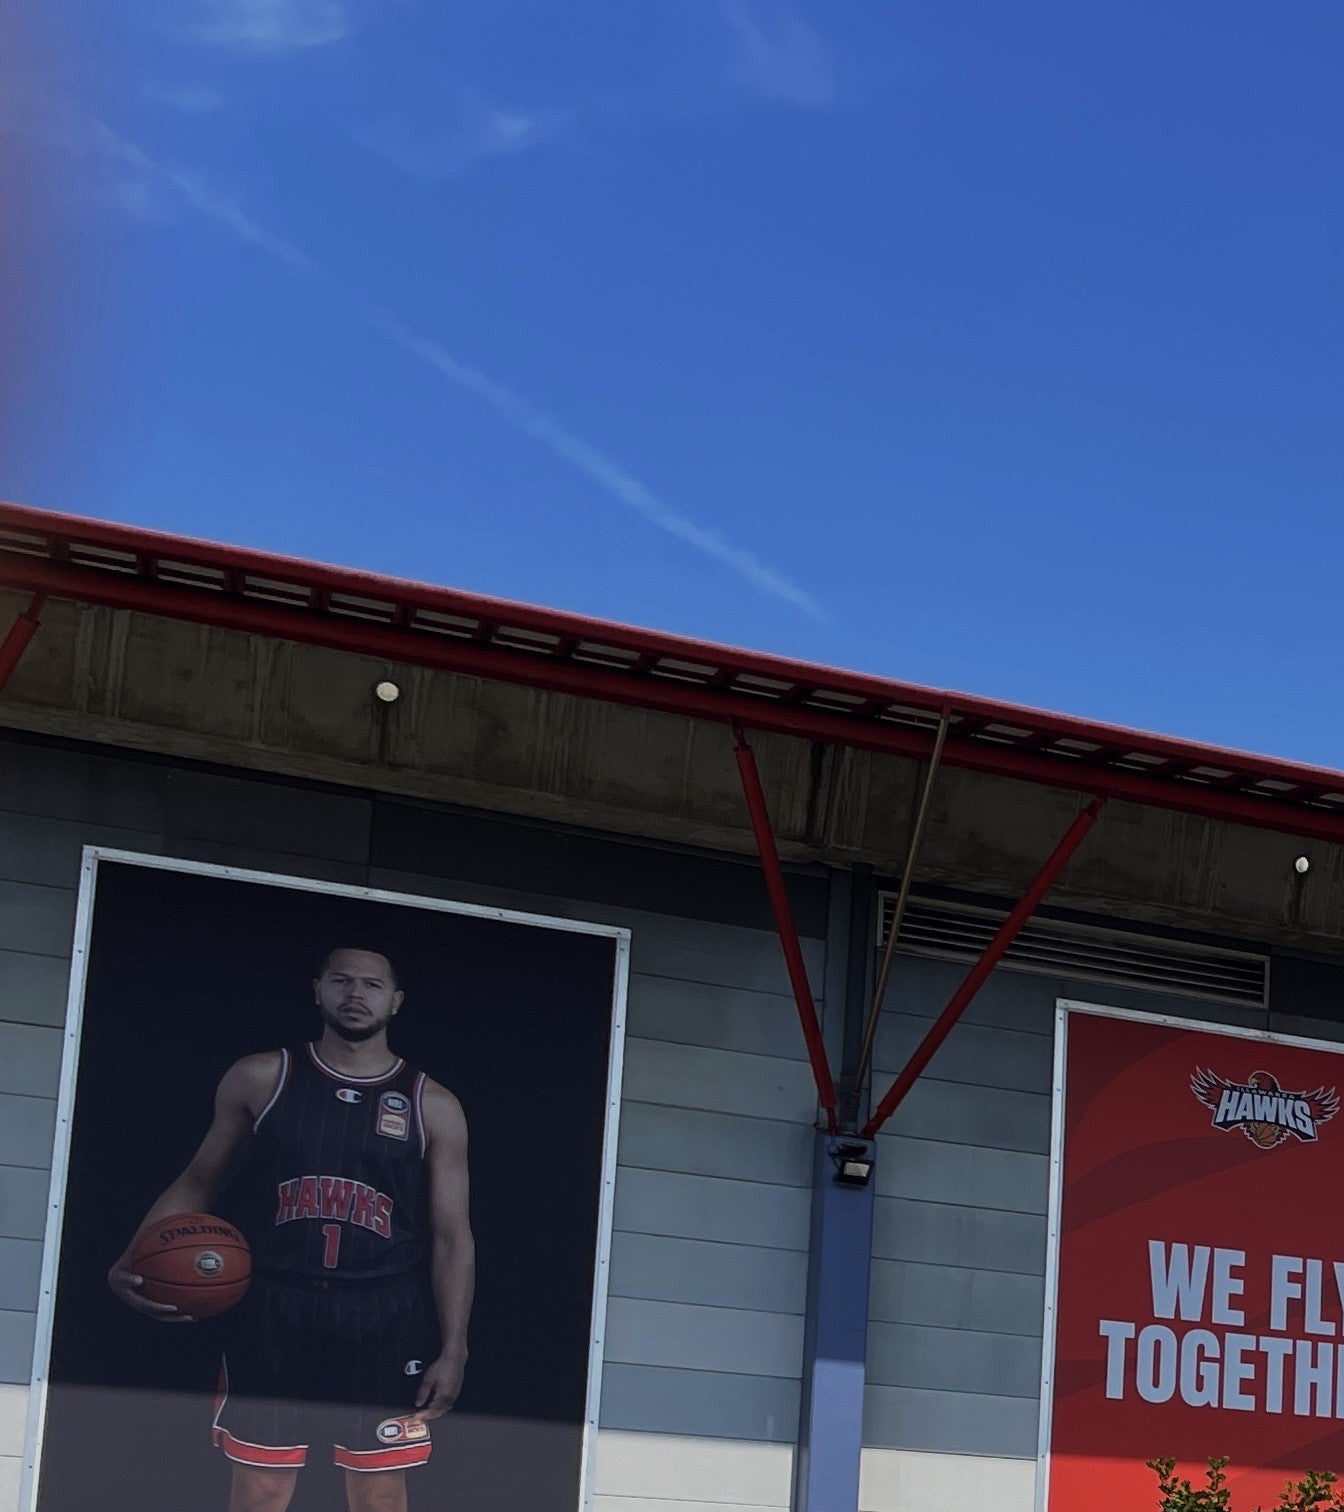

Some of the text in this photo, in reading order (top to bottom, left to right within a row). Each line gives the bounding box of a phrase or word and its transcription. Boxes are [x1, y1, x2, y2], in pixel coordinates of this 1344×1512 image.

[1215, 1090, 1316, 1138] HAWKS
[275, 1175, 394, 1239] HAWKS
[322, 1224, 342, 1269] 1
[1148, 1239, 1246, 1327] WE
